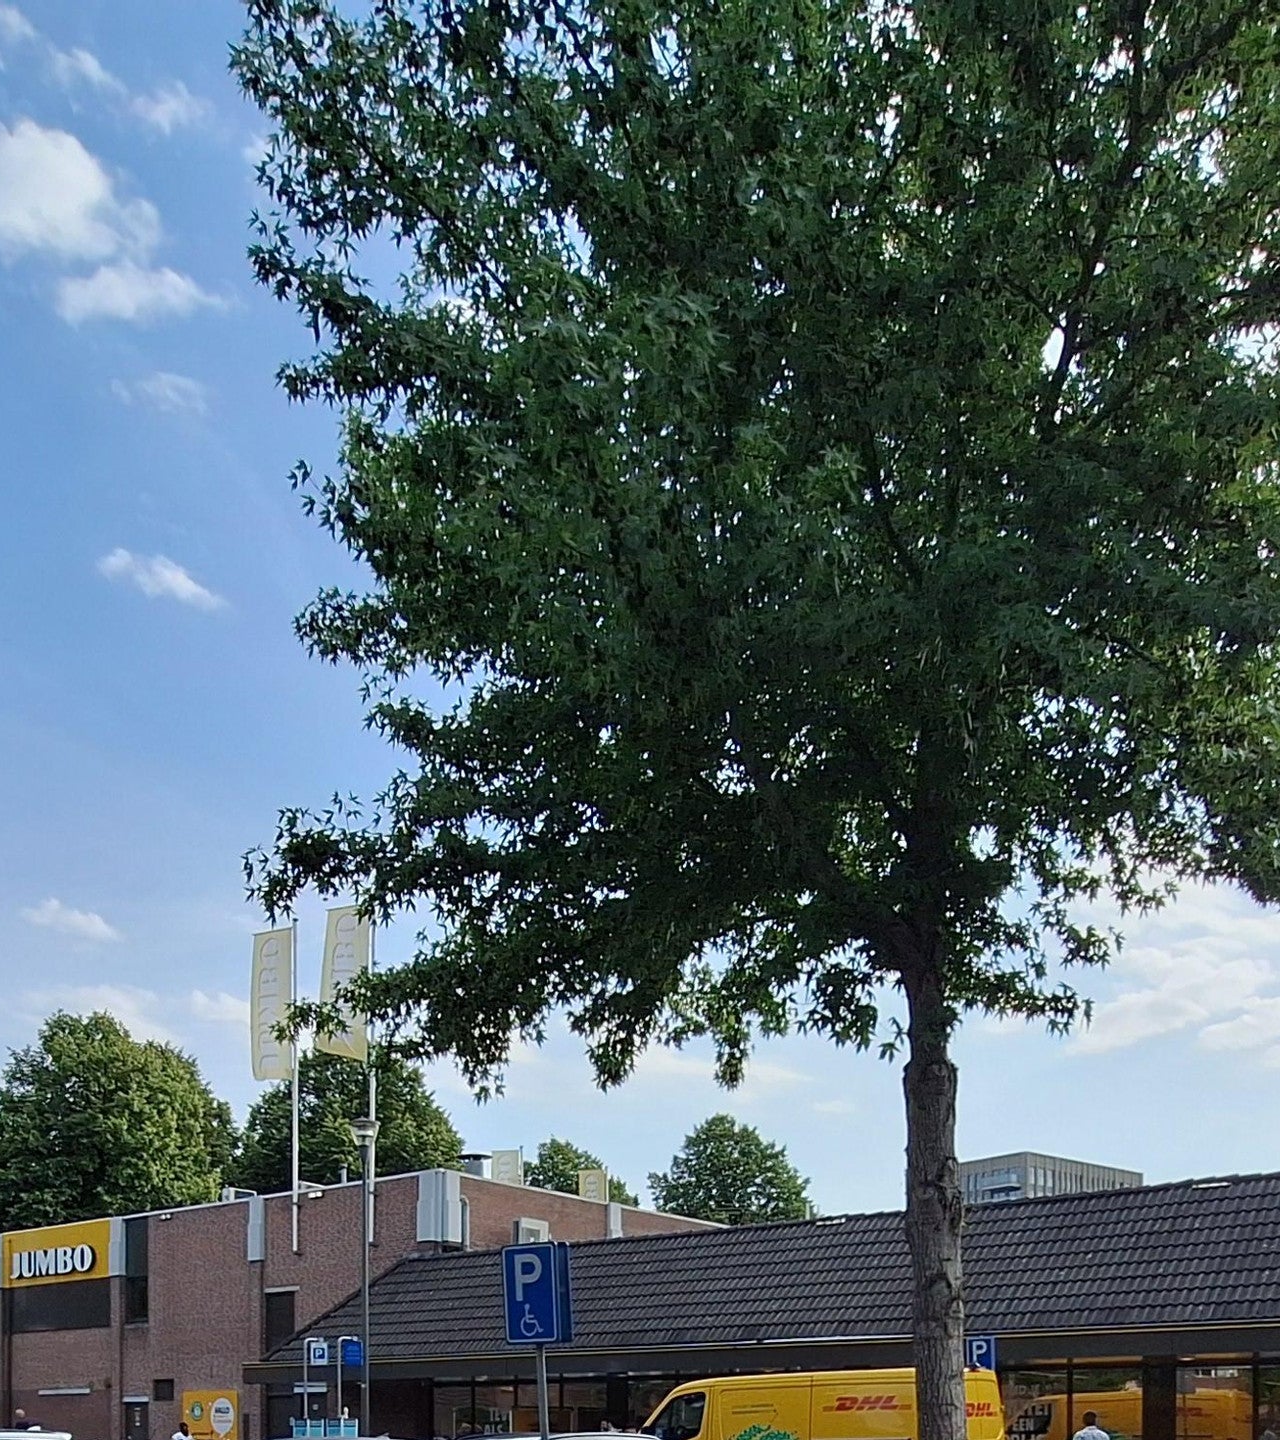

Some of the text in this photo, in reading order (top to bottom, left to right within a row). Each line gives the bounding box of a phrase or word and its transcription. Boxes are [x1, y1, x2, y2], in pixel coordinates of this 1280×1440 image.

[10, 1243, 93, 1279] JUMBO
[514, 1253, 542, 1301] P
[315, 1348, 323, 1358] P
[972, 1341, 987, 1364] P
[835, 1395, 898, 1412] DHL
[966, 1402, 995, 1417] DHL
